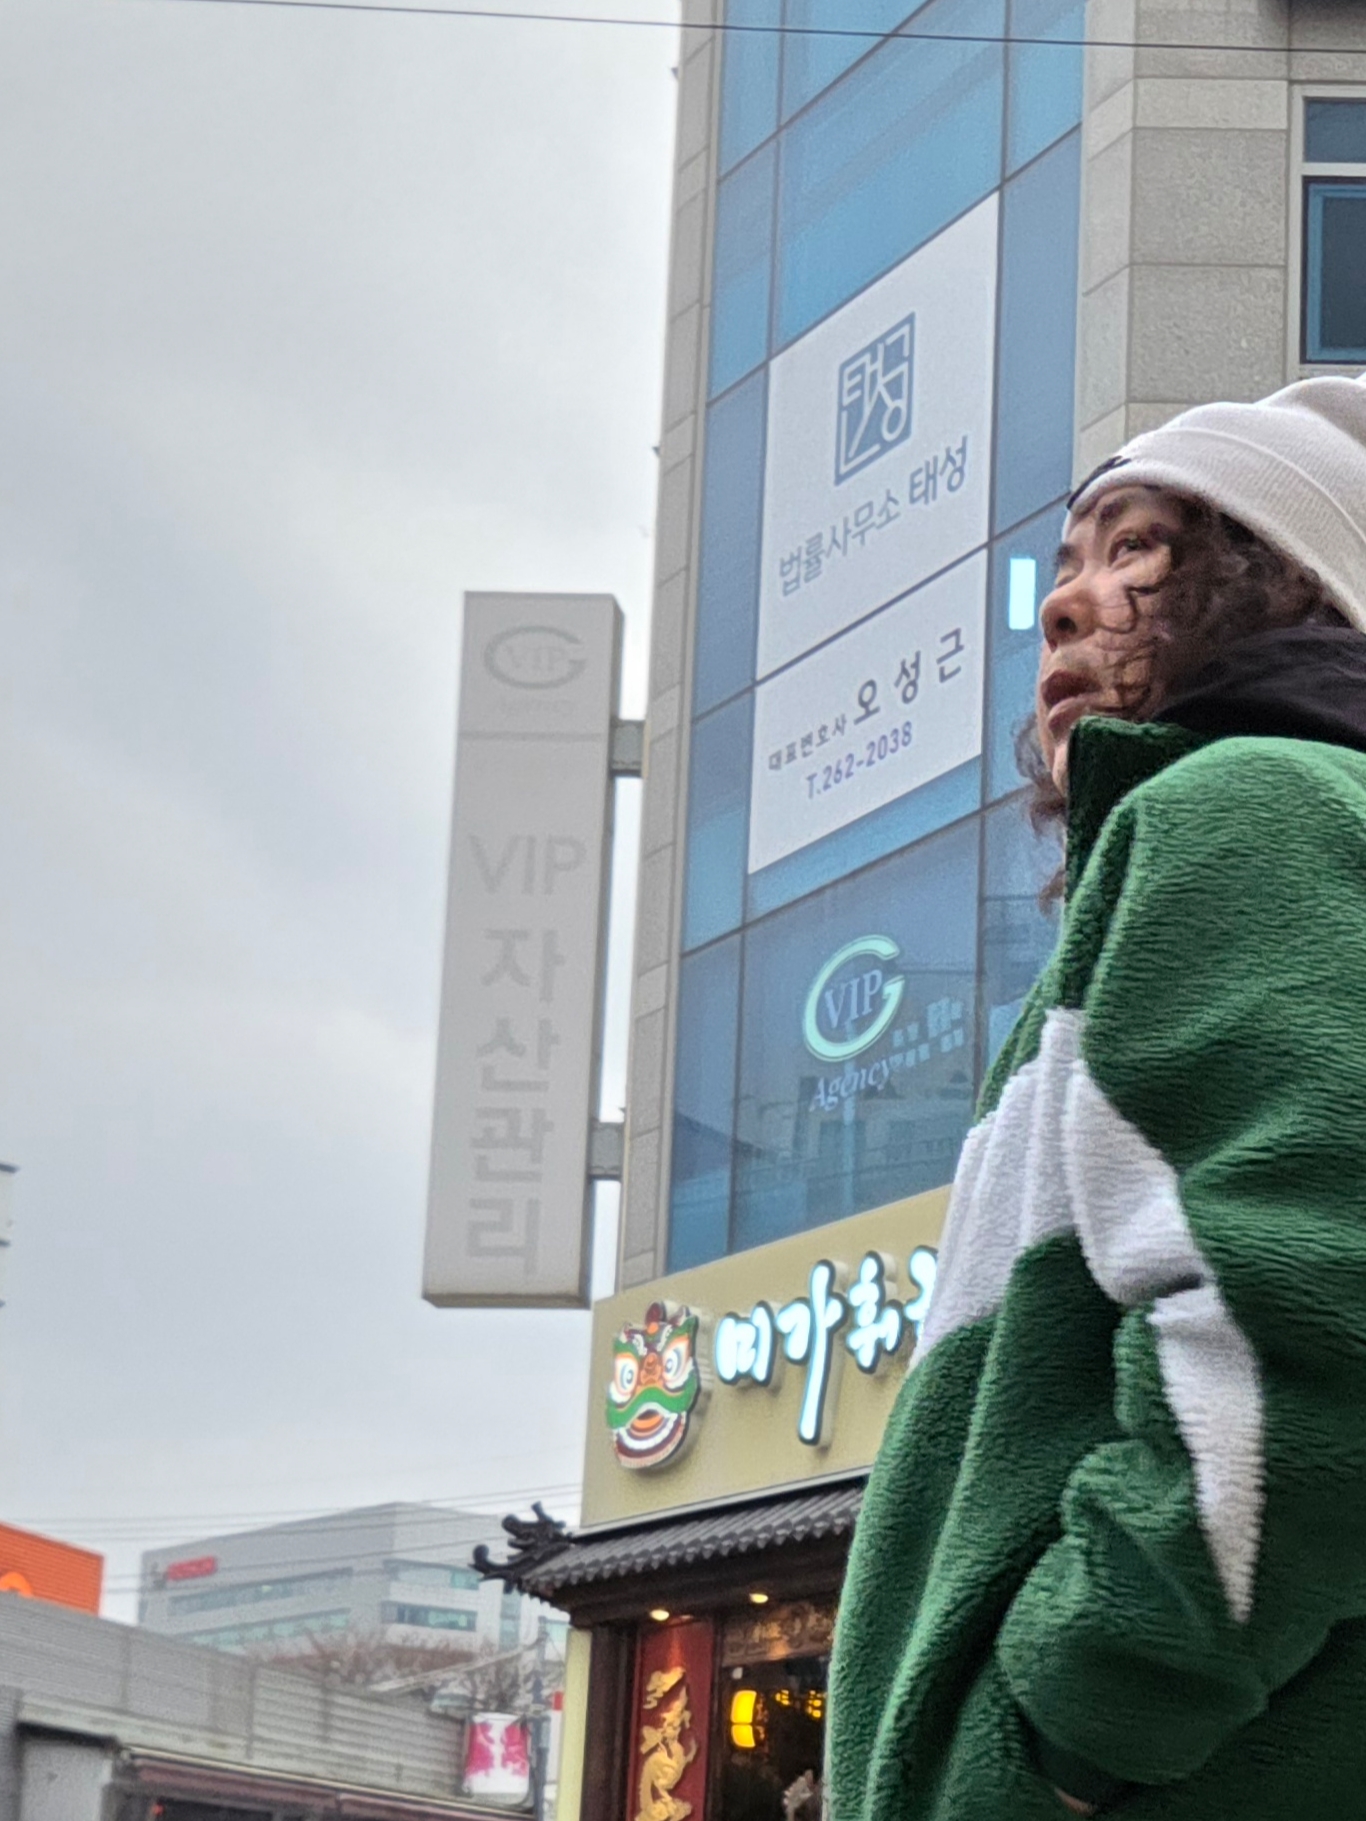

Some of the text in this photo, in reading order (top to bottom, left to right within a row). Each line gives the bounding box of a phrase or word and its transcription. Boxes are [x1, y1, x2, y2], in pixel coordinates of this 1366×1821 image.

[779, 434, 968, 597] 법률사무소 태성
[806, 720, 912, 799] T.262-2038
[466, 833, 588, 896] VIP
[824, 968, 883, 1030] VIP
[464, 928, 567, 1277] 자산관리
